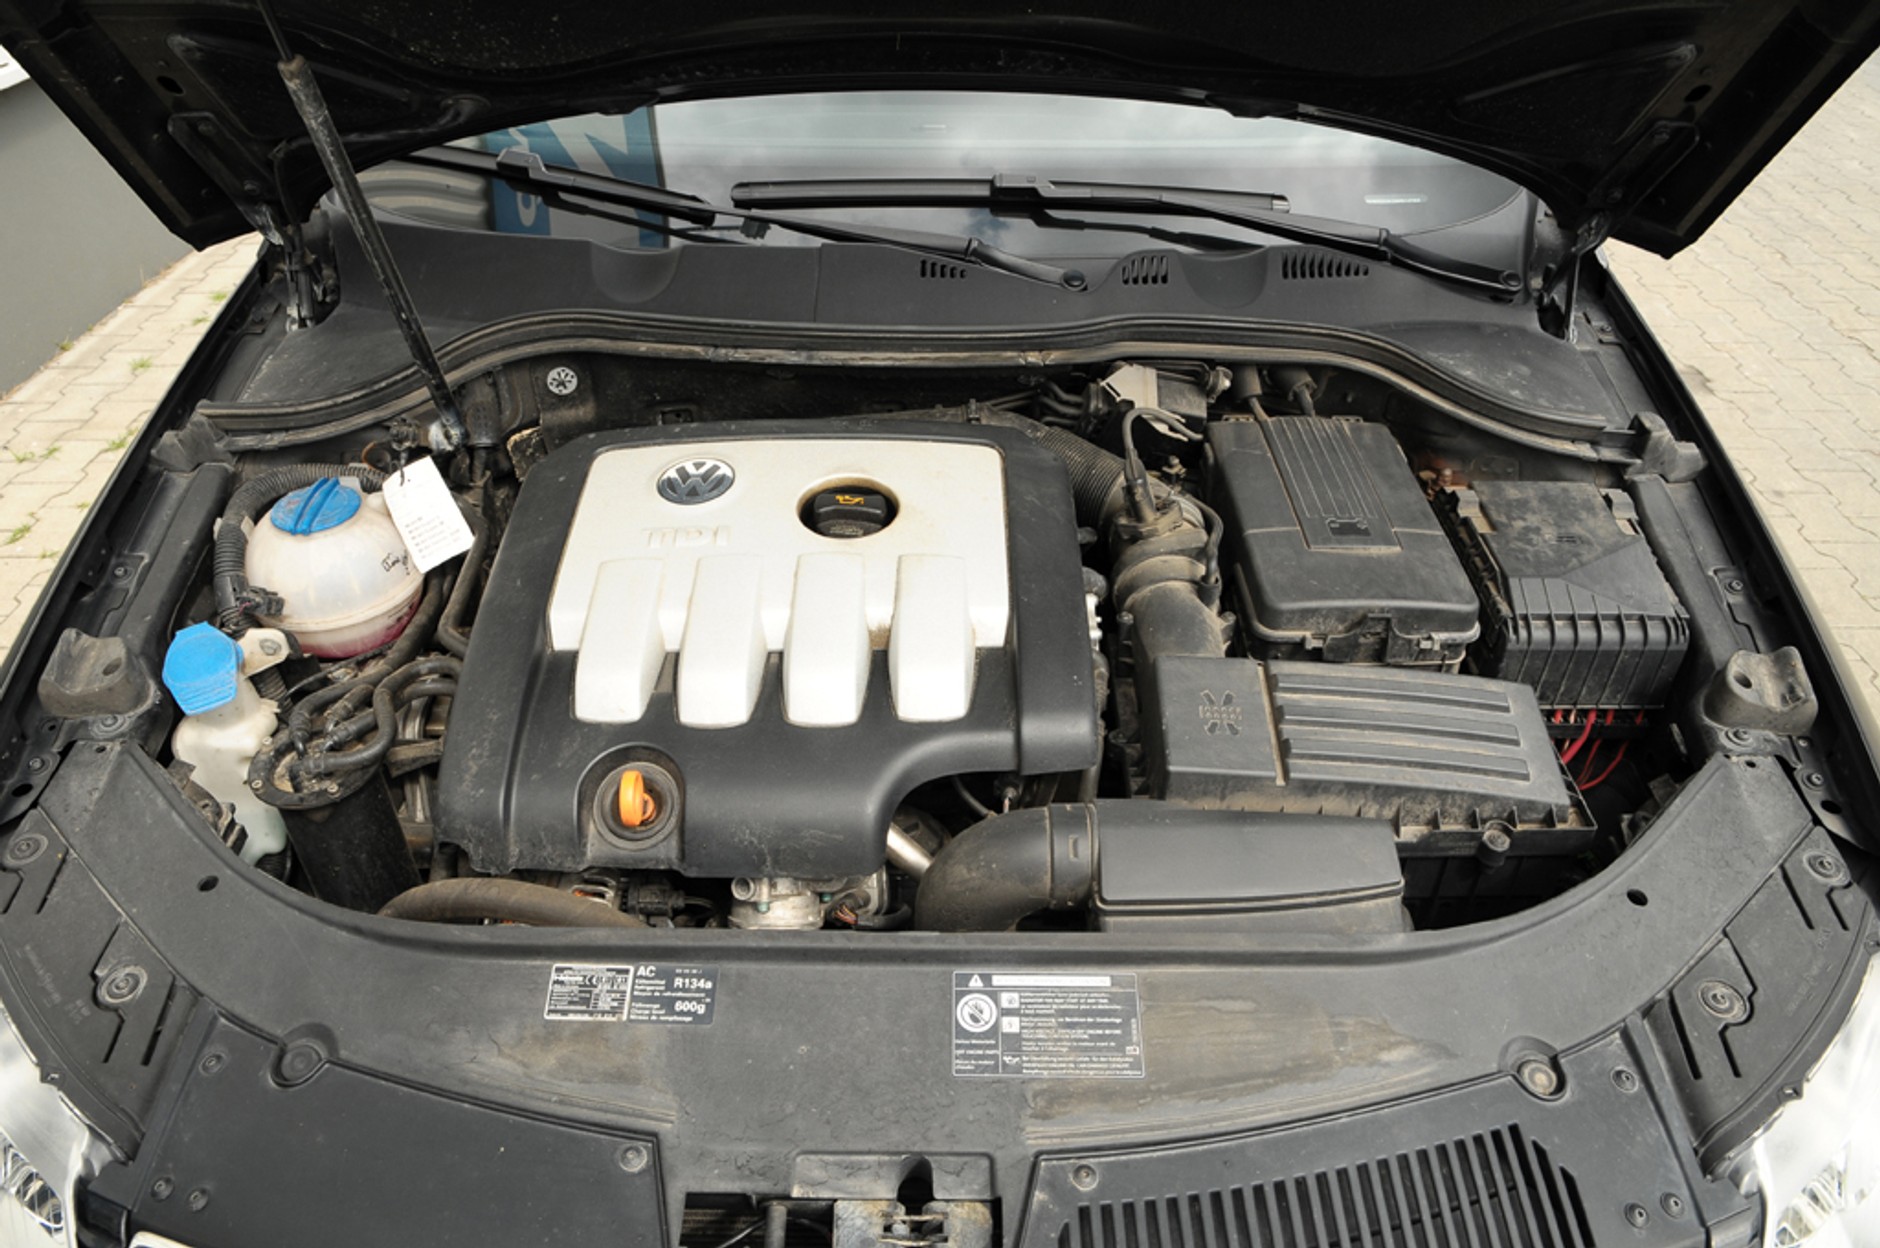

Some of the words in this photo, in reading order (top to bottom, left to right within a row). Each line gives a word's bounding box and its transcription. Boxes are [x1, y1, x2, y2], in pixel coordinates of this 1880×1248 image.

[642, 526, 731, 548] TDI
[636, 965, 656, 977] AC
[673, 977, 713, 989] R134a
[674, 1000, 706, 1014] 600g
